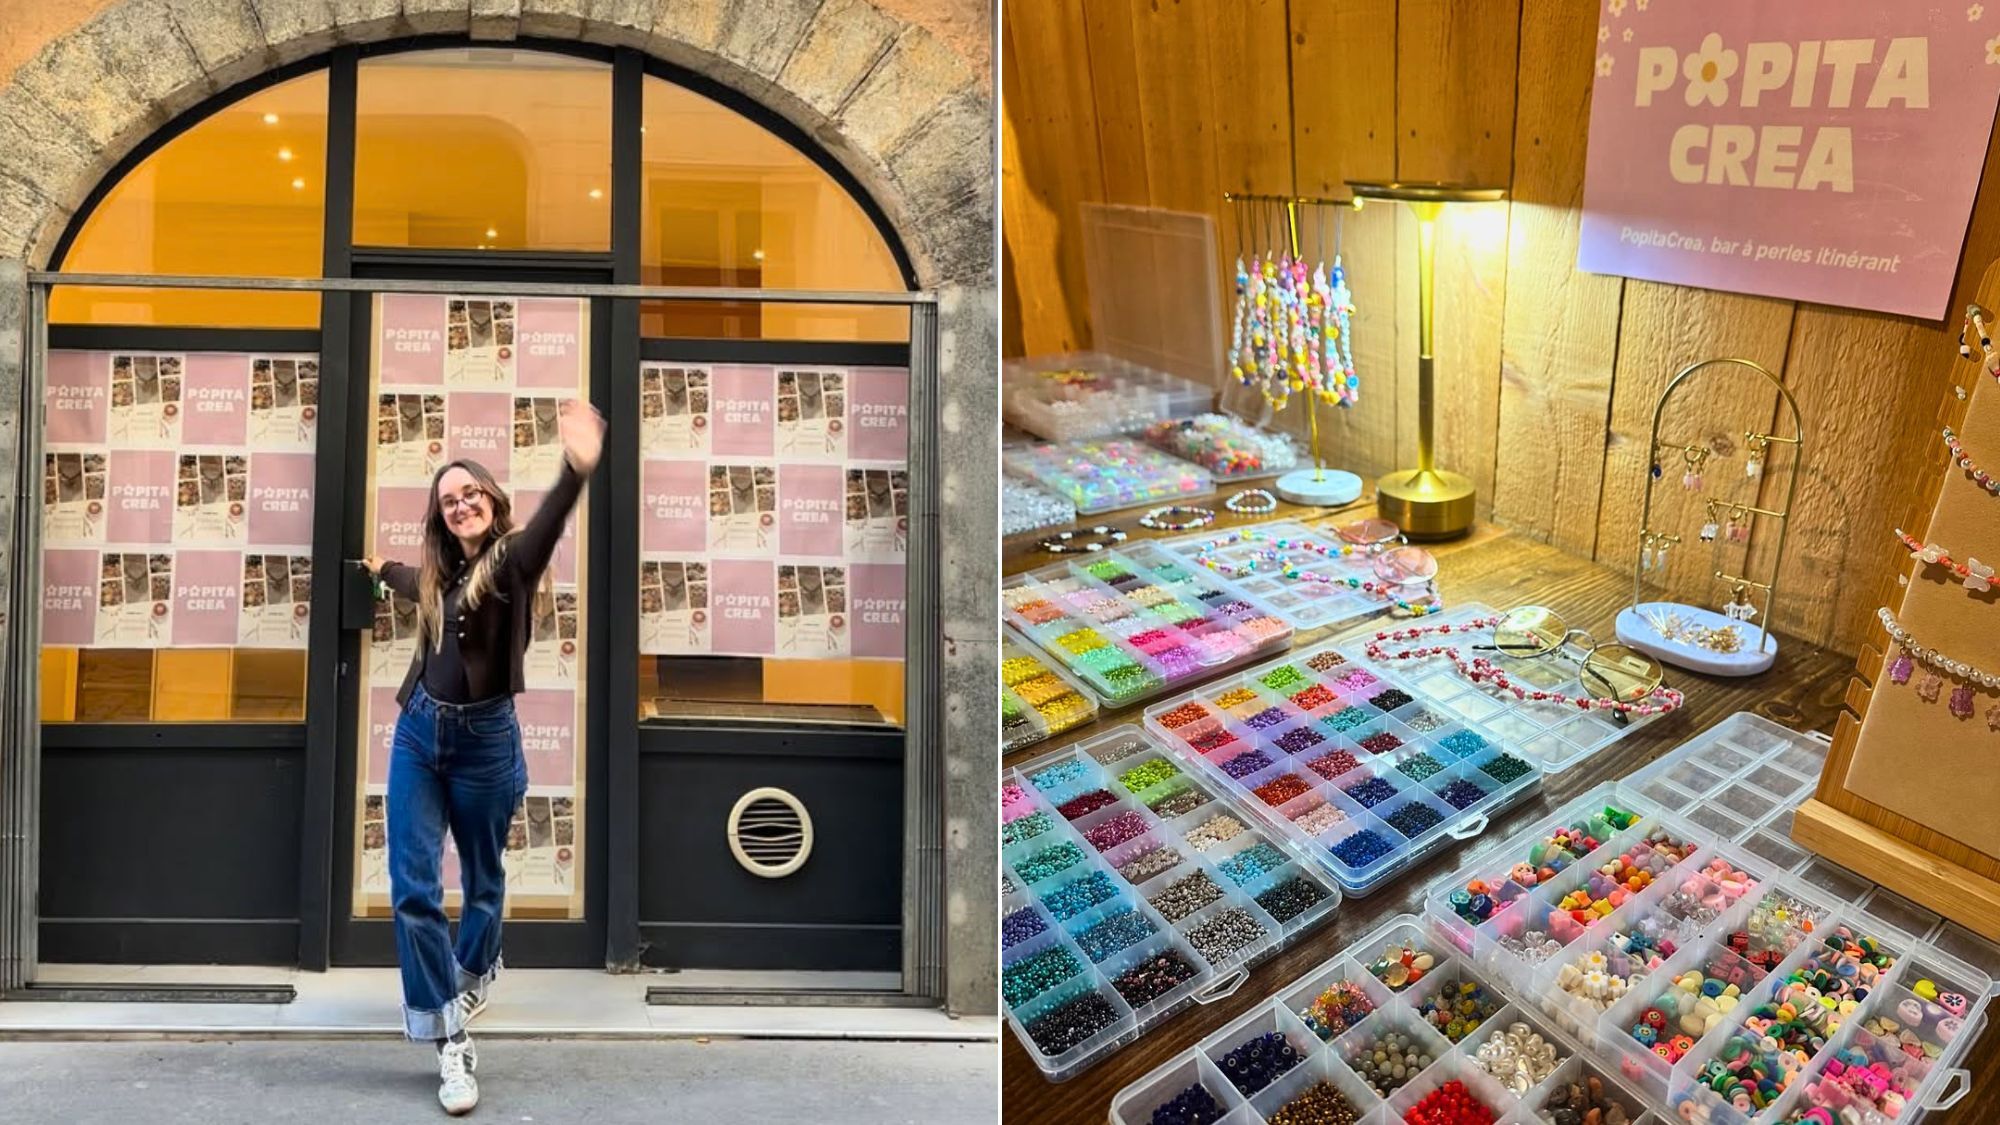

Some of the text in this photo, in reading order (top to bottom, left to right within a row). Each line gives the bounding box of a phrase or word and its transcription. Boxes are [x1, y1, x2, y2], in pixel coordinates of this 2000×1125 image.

[1669, 124, 1854, 193] CREA
[1620, 226, 1705, 253] PopitaCrea,
[1711, 236, 1740, 255] bar
[1754, 243, 1812, 264] perles
[1815, 247, 1901, 273] itinérant
[395, 341, 432, 353] CREA
[530, 345, 566, 356] CREA
[56, 399, 94, 410] CREA
[196, 401, 234, 412] CREA
[724, 413, 762, 424] CREA
[860, 417, 898, 428] CREA
[460, 439, 498, 449] CREA
[121, 499, 160, 510] CREA
[262, 501, 300, 512] CREA
[656, 507, 694, 518] CREA
[793, 511, 829, 523] CREA
[187, 599, 226, 611] CREA
[724, 608, 762, 619] CREA
[863, 612, 900, 623] CREA
